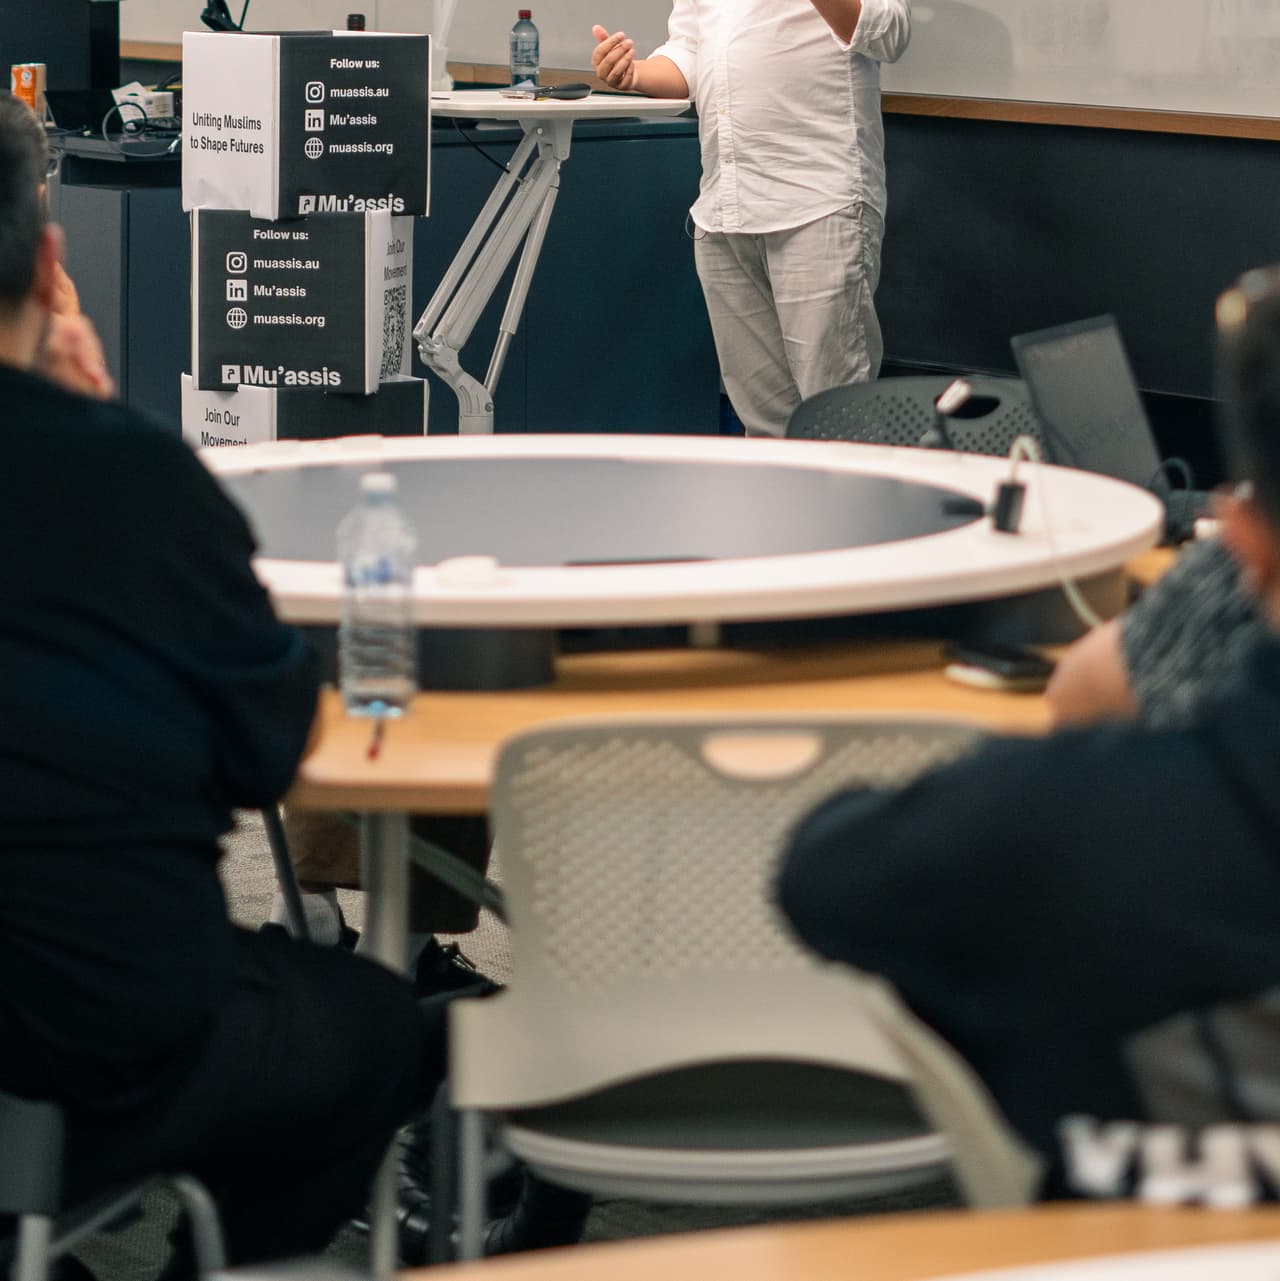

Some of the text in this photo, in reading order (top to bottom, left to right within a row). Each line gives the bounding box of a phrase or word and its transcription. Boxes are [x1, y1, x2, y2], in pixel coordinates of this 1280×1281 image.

[329, 58, 380, 69] Follow us:
[330, 86, 389, 97] muassis.au
[192, 112, 262, 131] Uniting Muslims
[329, 114, 377, 125] Mu'assis
[190, 136, 264, 154] to Shape Futures
[329, 141, 394, 154] muassis.org
[317, 193, 406, 213] Mu'assis
[253, 229, 309, 240] Follow us:
[253, 258, 320, 269] muassis.au
[253, 285, 307, 297] Mu'assis
[253, 313, 326, 328] muassis.org
[243, 365, 342, 386] Mu'assis
[204, 407, 241, 427] Join Our
